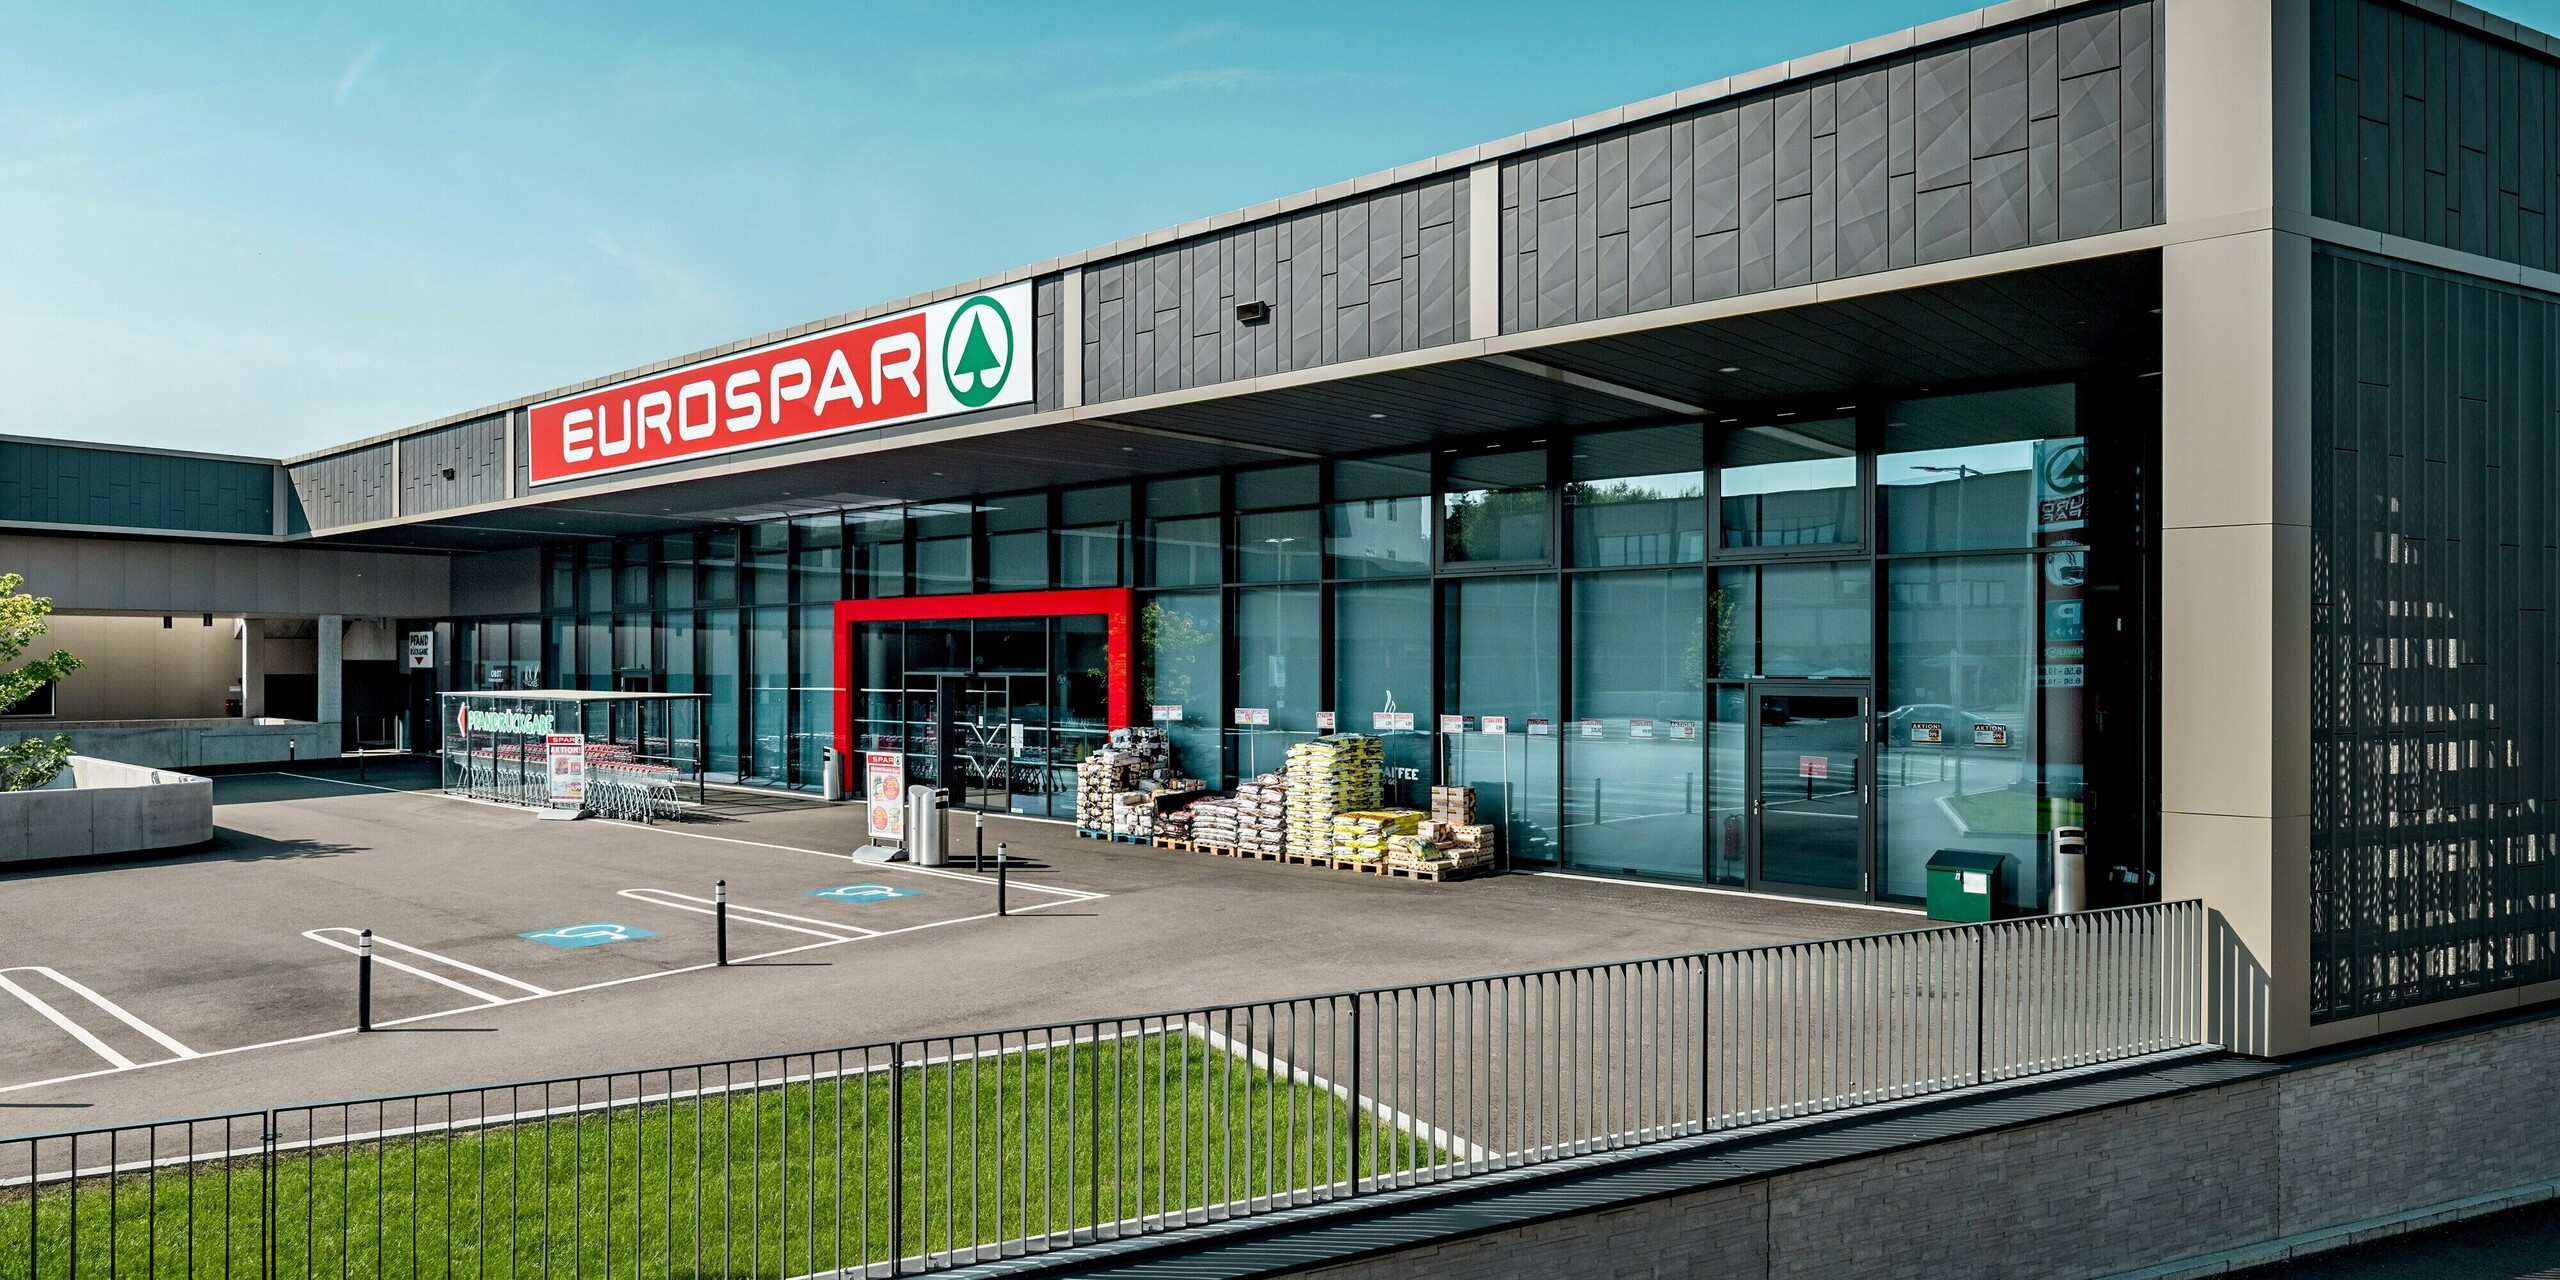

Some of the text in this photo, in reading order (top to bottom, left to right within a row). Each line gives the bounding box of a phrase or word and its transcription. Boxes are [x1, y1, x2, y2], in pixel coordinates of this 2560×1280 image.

[563, 332, 921, 464] EUROSPAR
[410, 634, 429, 646] PFAND
[468, 709, 554, 735] PFANDRÜCKGABE
[551, 745, 581, 754] AKTION!
[872, 756, 894, 765] SPAR
[1382, 766, 1420, 781] AFFEE
